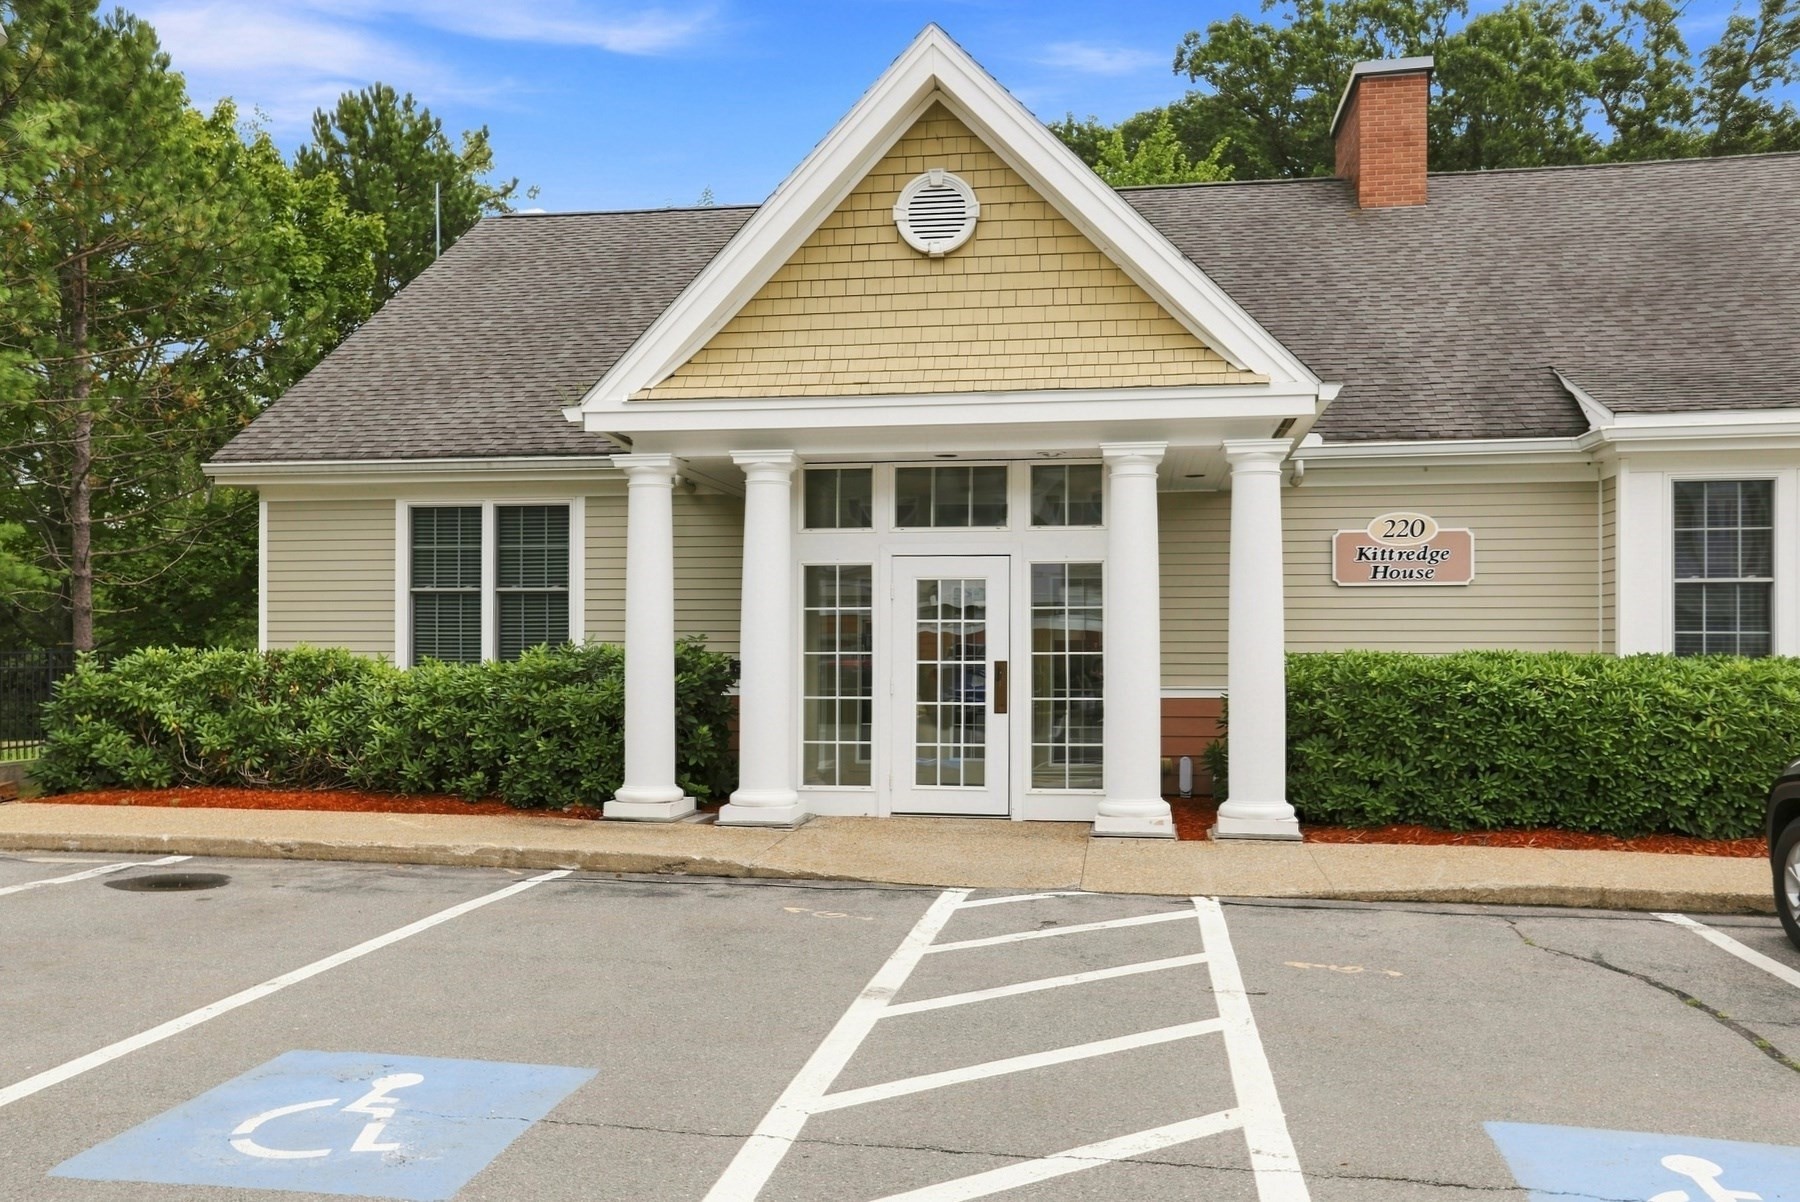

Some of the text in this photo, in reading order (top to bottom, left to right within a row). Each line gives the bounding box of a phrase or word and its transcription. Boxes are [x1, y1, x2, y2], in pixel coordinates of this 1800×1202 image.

[1382, 518, 1425, 538] 220
[1355, 545, 1450, 565] Kittredge
[1370, 565, 1435, 580] House
